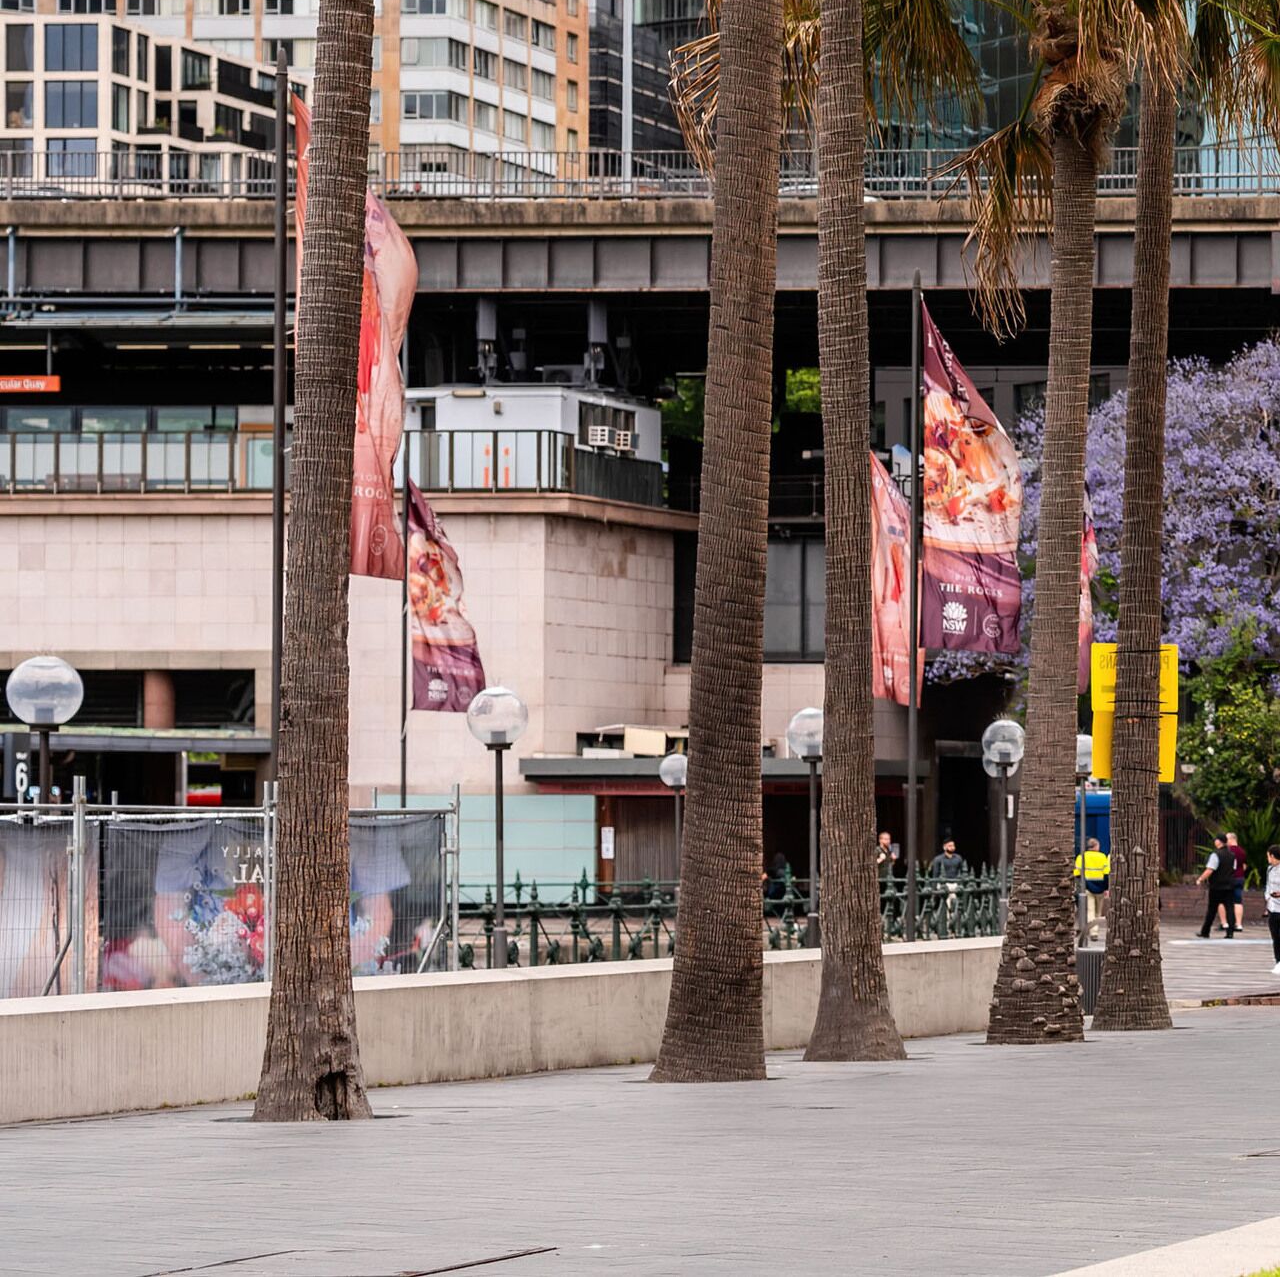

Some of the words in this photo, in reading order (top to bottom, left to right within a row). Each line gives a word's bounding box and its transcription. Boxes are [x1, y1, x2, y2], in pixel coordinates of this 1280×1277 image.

[353, 486, 388, 500] ROC
[940, 583, 963, 593] THE
[943, 619, 967, 631] NSW
[16, 762, 28, 793] 6
